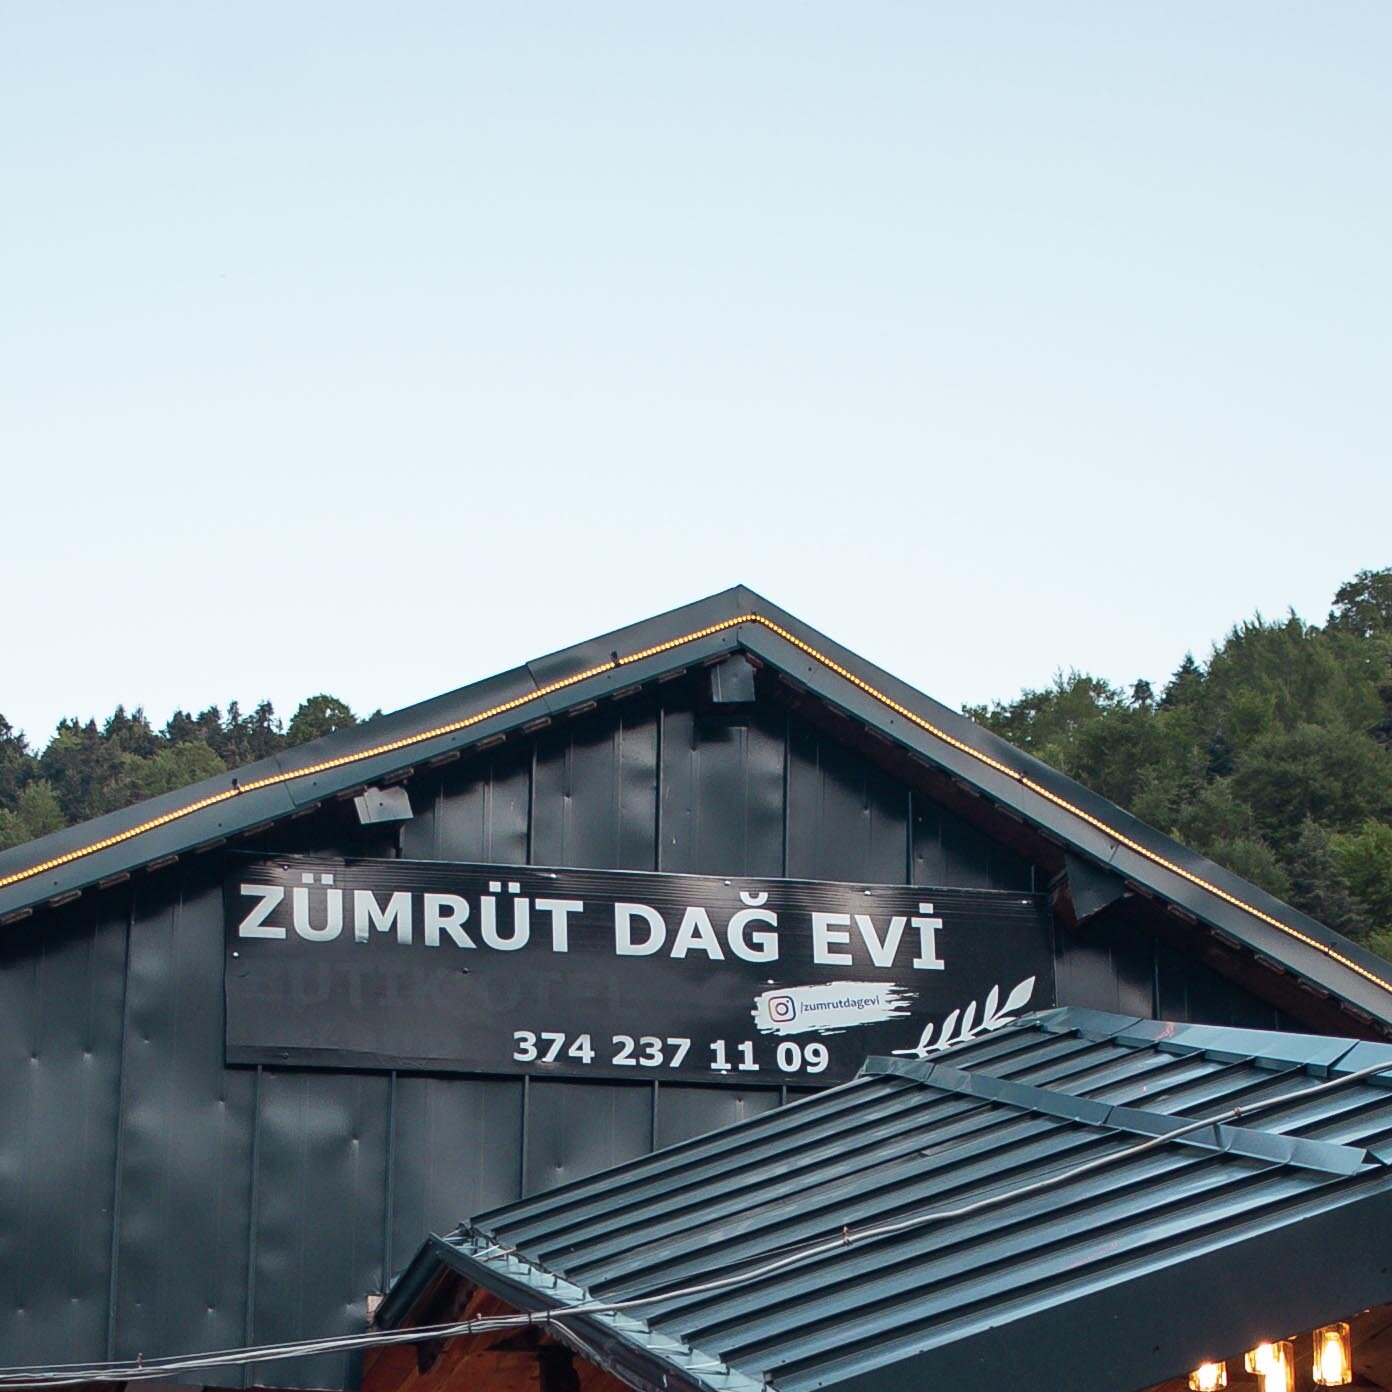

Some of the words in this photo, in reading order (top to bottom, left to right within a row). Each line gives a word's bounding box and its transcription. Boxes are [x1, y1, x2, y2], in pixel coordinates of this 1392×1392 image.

[239, 872, 584, 953] ZÜMRÜT
[615, 891, 779, 963] DAĞ
[812, 902, 945, 970] EVİ
[513, 1030, 596, 1064] 374
[611, 1034, 691, 1068] 237
[709, 1039, 760, 1071] 11
[776, 1041, 829, 1074] 09
